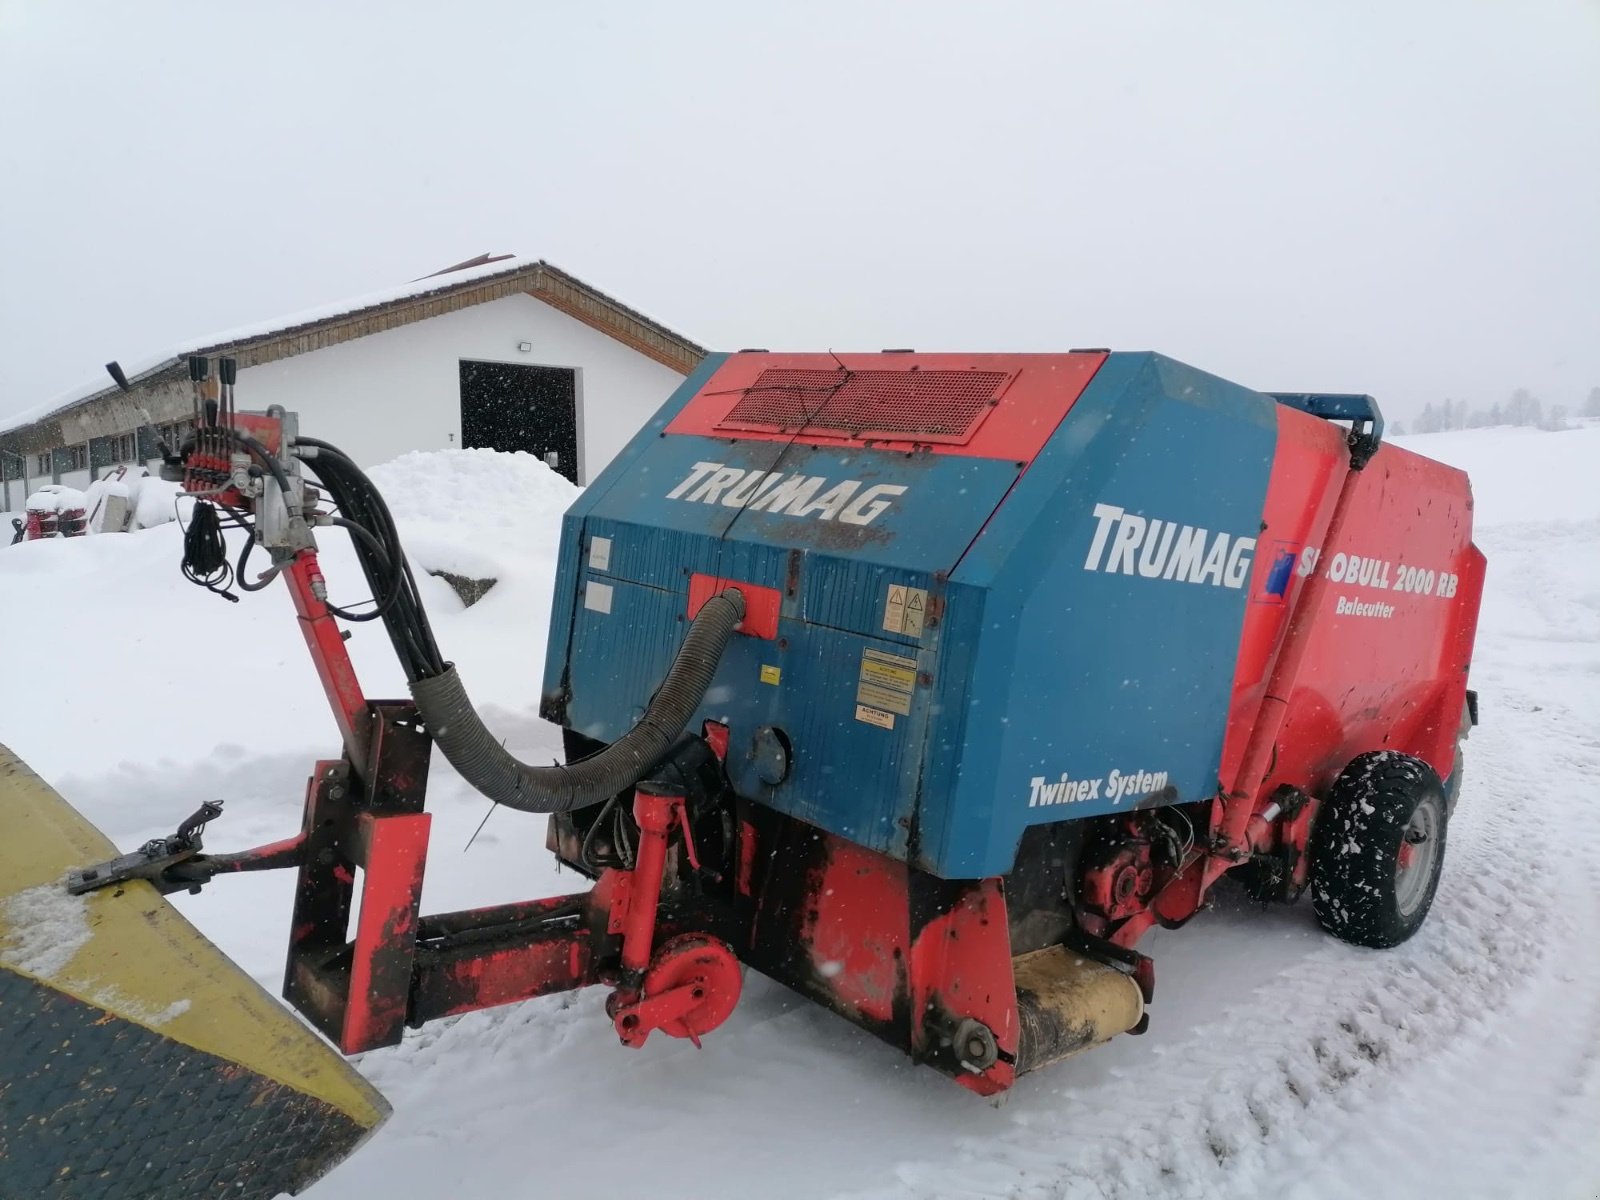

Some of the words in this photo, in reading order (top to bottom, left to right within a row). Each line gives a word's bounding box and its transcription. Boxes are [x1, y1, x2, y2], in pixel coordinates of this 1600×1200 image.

[665, 461, 909, 525] TRUMAG
[1084, 503, 1257, 589] TRUMAG
[1297, 546, 1390, 589] SIOBULL
[1392, 564, 1435, 595] 2000
[1436, 572, 1459, 599] RB
[1336, 596, 1396, 619] Balecutter
[862, 707, 889, 719] ACHTUNG
[1028, 772, 1103, 808] Twinex
[1105, 769, 1168, 805] System
